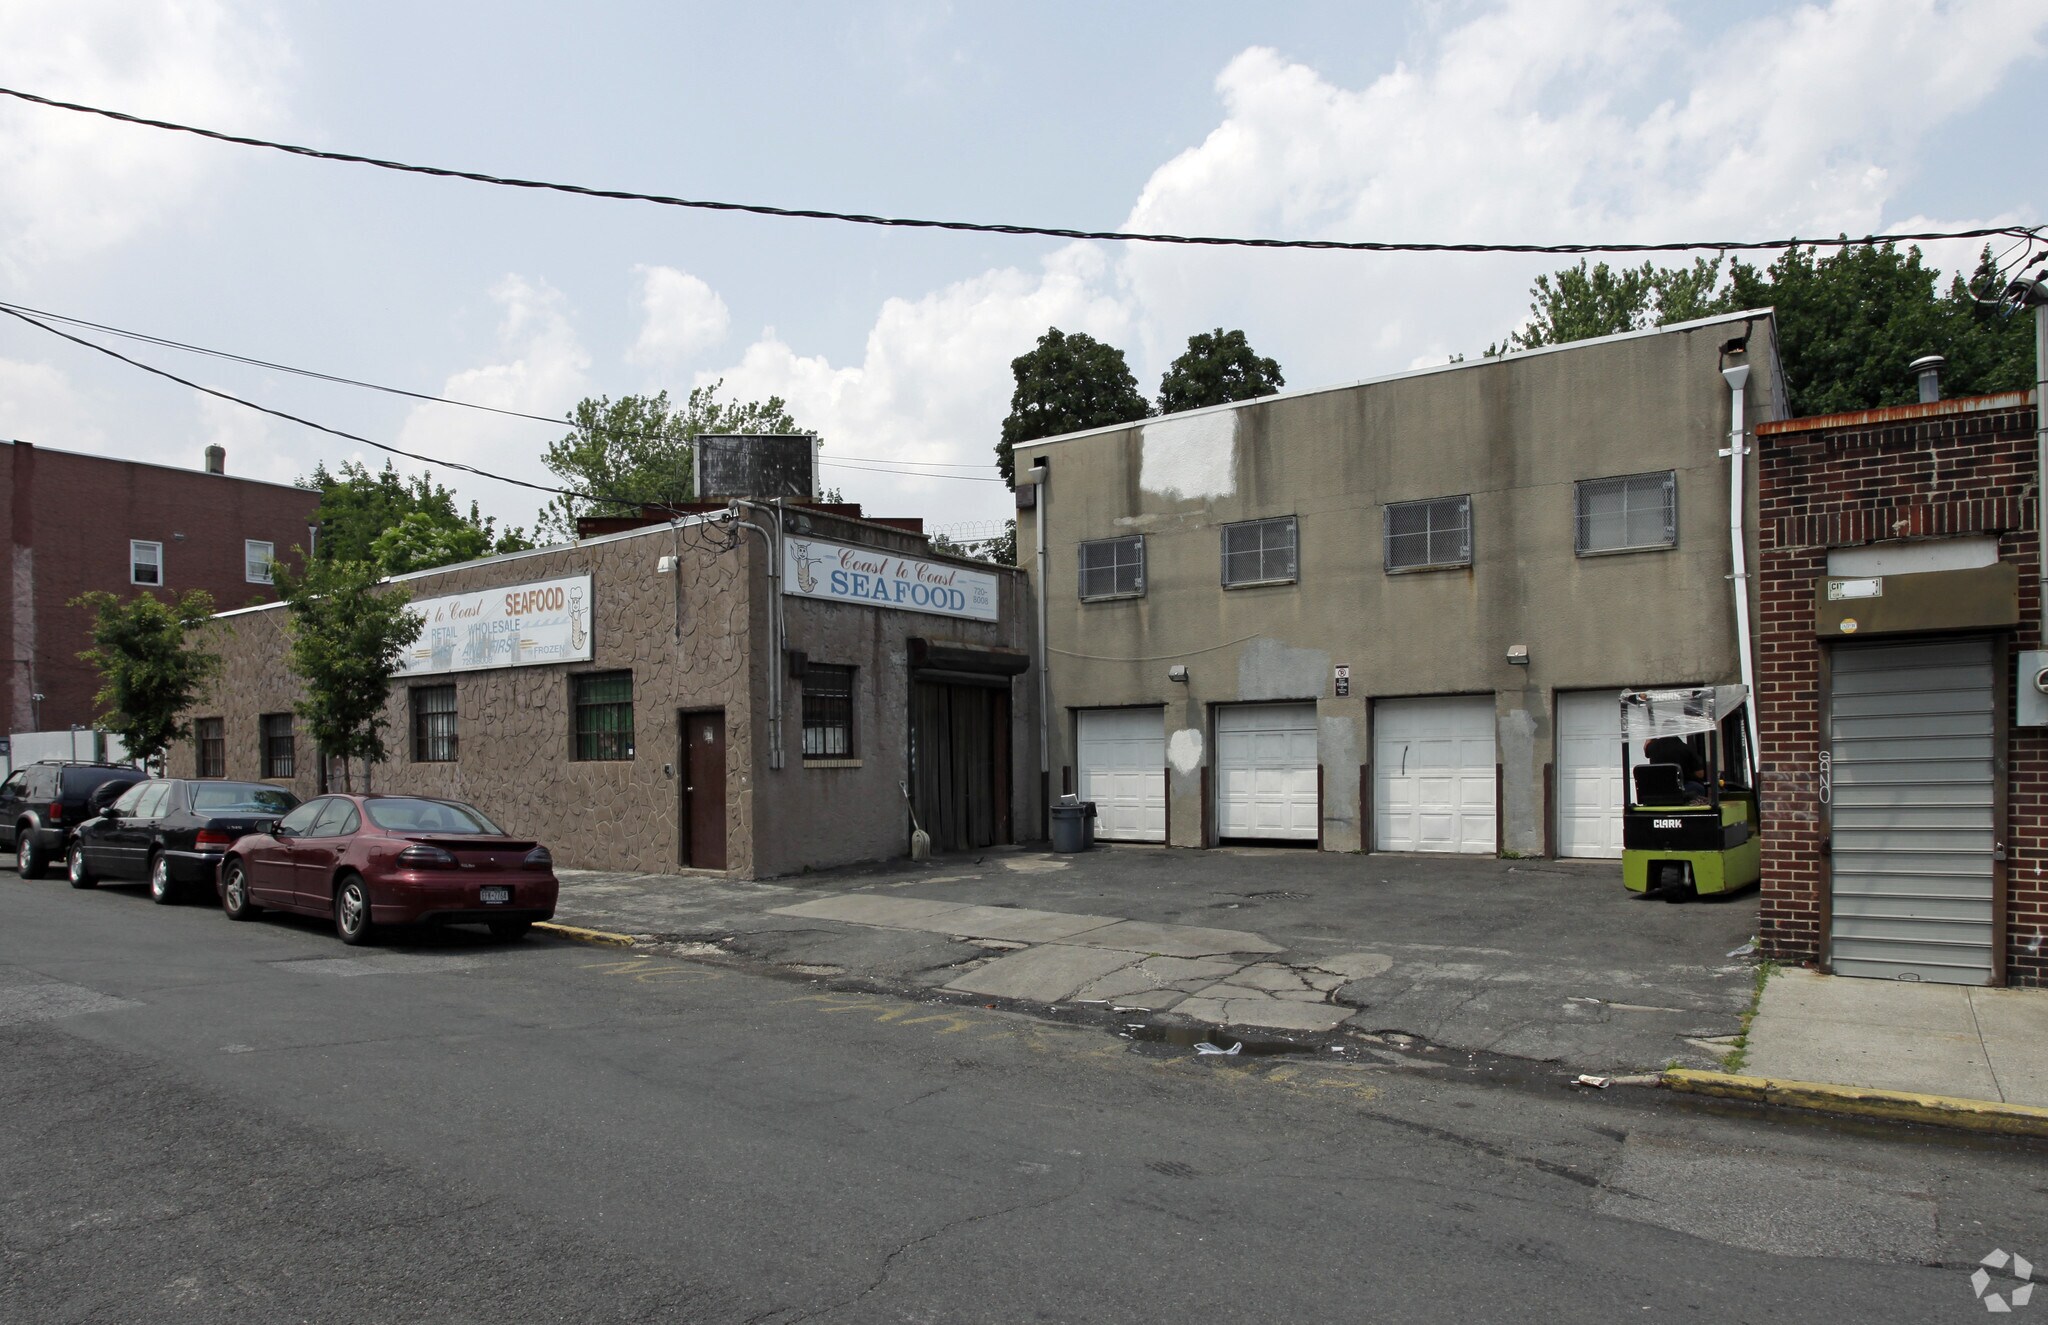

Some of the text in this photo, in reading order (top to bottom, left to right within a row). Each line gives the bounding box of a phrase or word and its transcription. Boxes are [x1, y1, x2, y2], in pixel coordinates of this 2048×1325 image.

[838, 547, 957, 587] Coast to Coast
[449, 598, 484, 620] Coast
[505, 586, 565, 617] SEAFOOD
[830, 569, 966, 611] SEAFOOD
[431, 618, 521, 641] RETAIL WHOLESALE
[533, 644, 566, 655] FROZEN
[1653, 819, 1682, 829] CLARK
